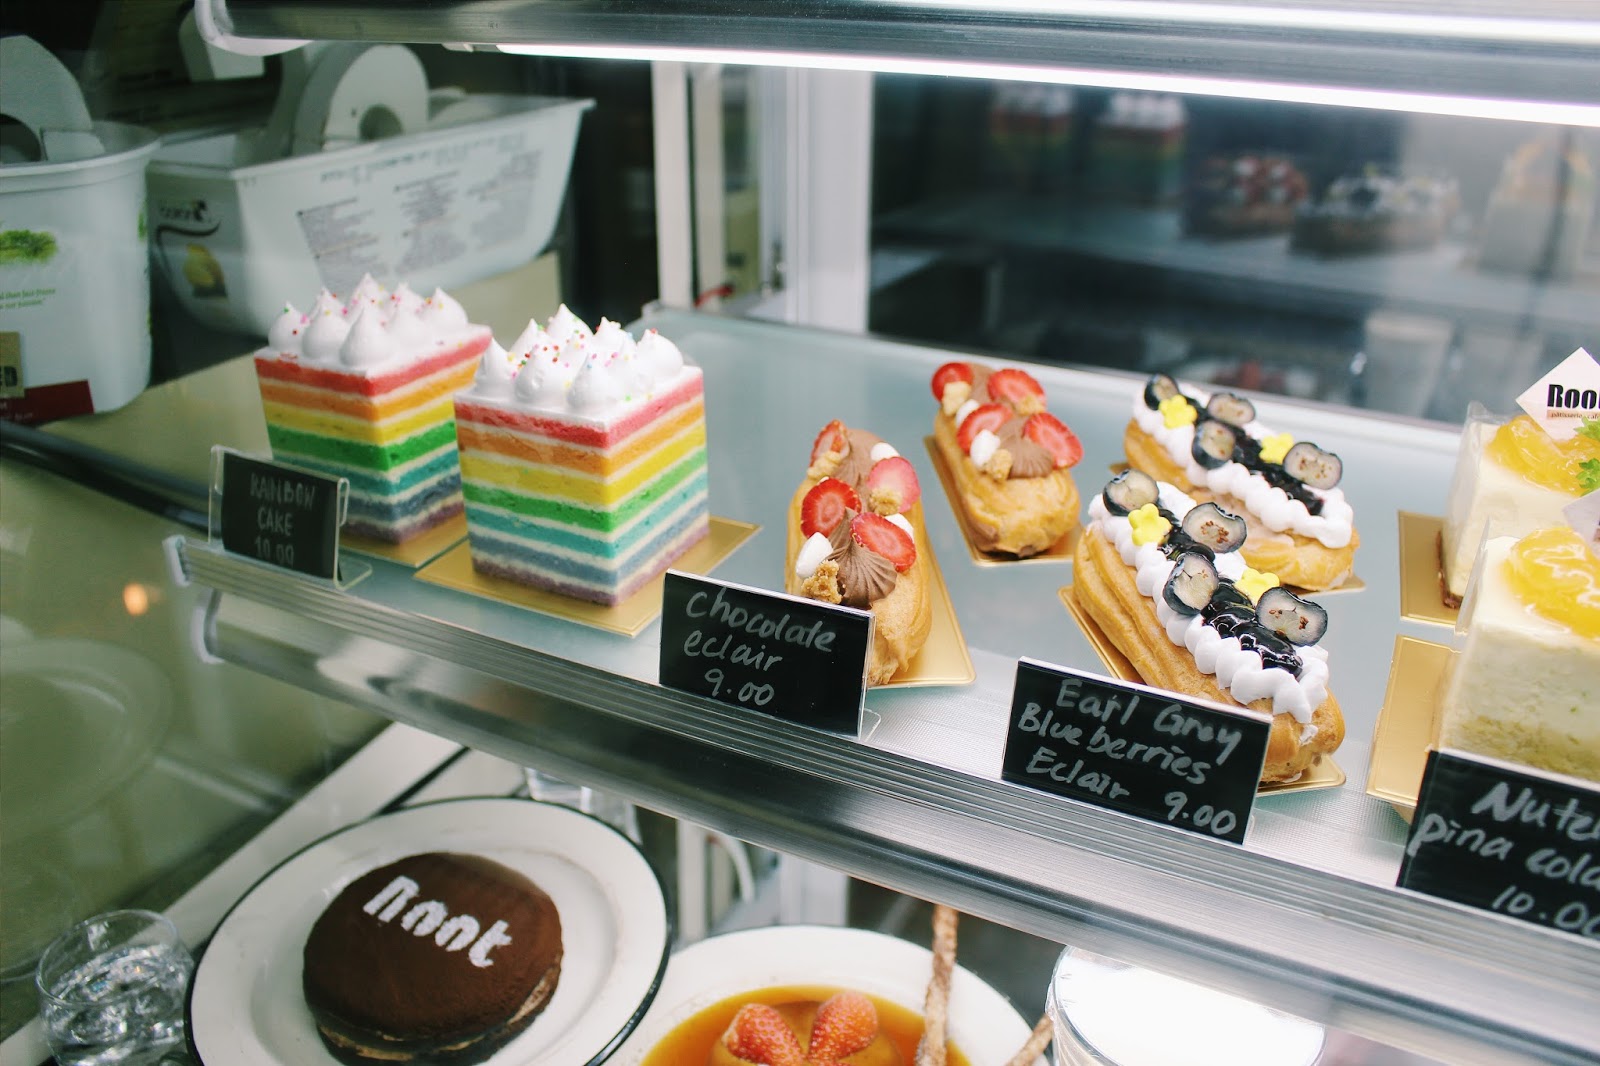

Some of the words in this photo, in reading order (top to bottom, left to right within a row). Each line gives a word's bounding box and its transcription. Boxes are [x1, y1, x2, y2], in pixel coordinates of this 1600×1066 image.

[1547, 384, 1600, 410] Roo
[249, 471, 316, 511] RAINBOW
[256, 505, 294, 537] CAKE
[685, 586, 837, 652] Chocolate
[683, 630, 783, 672] eclair
[704, 668, 775, 706] 9.00
[1056, 678, 1140, 726] Earl
[1153, 704, 1242, 766] Grey
[1025, 746, 1130, 800] Eclair
[1164, 791, 1237, 835] 9.00
